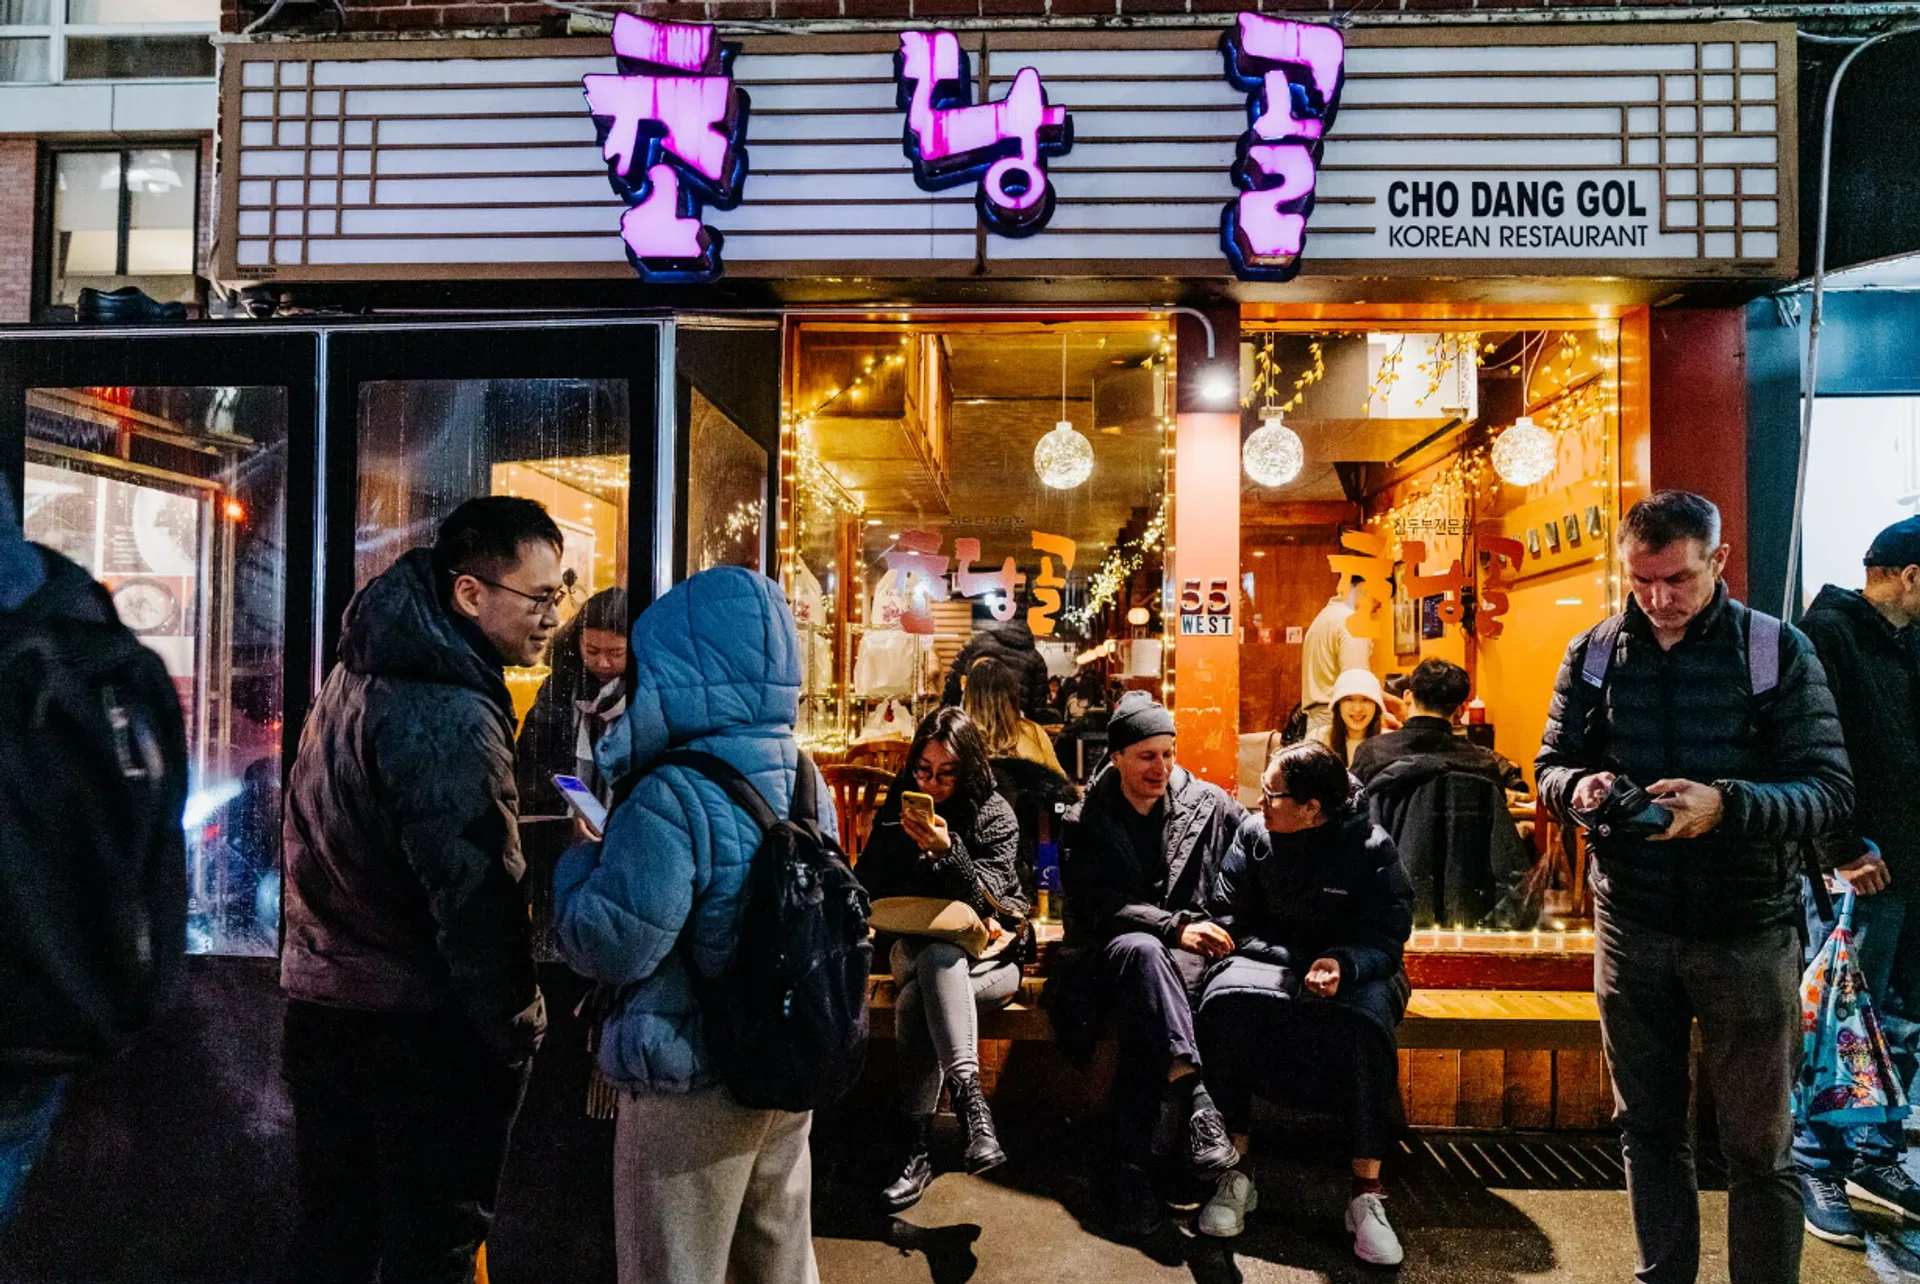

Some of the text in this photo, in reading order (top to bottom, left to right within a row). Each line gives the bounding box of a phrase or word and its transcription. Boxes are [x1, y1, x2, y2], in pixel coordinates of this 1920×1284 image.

[1387, 179, 1647, 218] CHO DANG GOL
[1389, 224, 1649, 248] KOREAN RESTAURANT
[1180, 577, 1231, 615] 55
[1182, 615, 1233, 635] WEST
